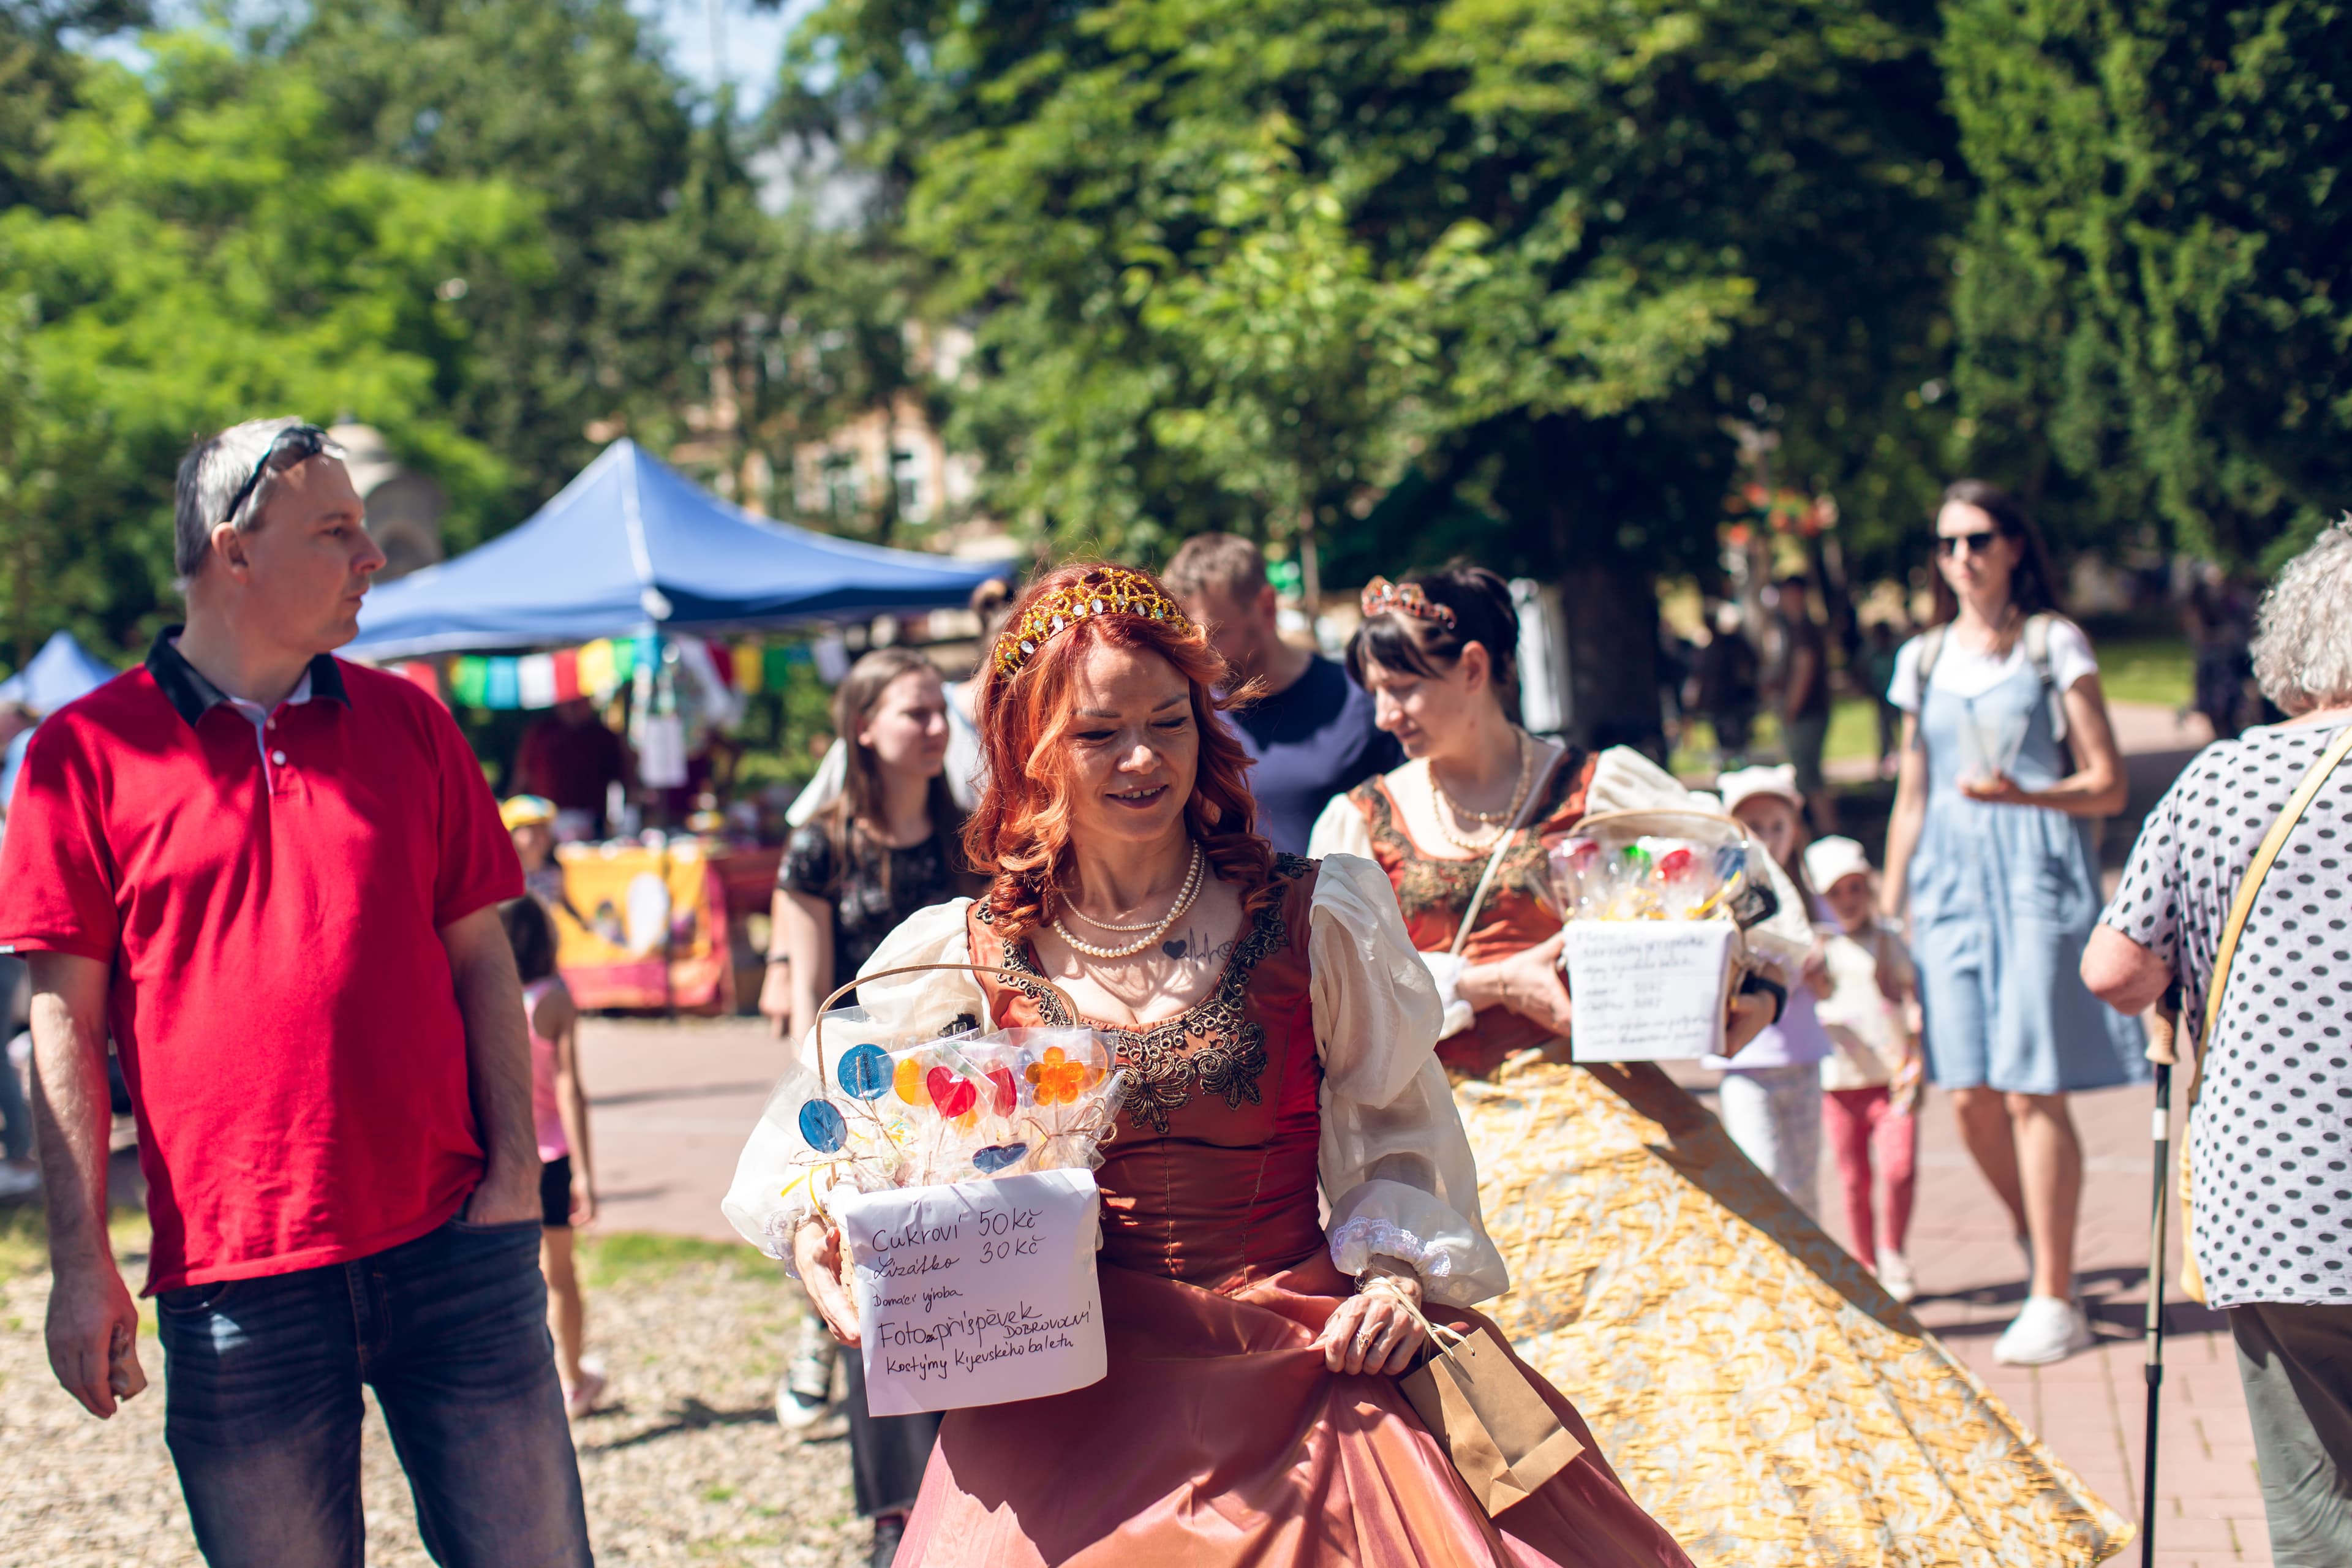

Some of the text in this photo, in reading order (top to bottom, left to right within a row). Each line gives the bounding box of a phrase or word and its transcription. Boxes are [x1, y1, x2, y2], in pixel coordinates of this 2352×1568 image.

[872, 1213, 962, 1252] Cukroví
[923, 1286, 963, 1313] výroba
[1028, 1333, 1074, 1353] baletu
